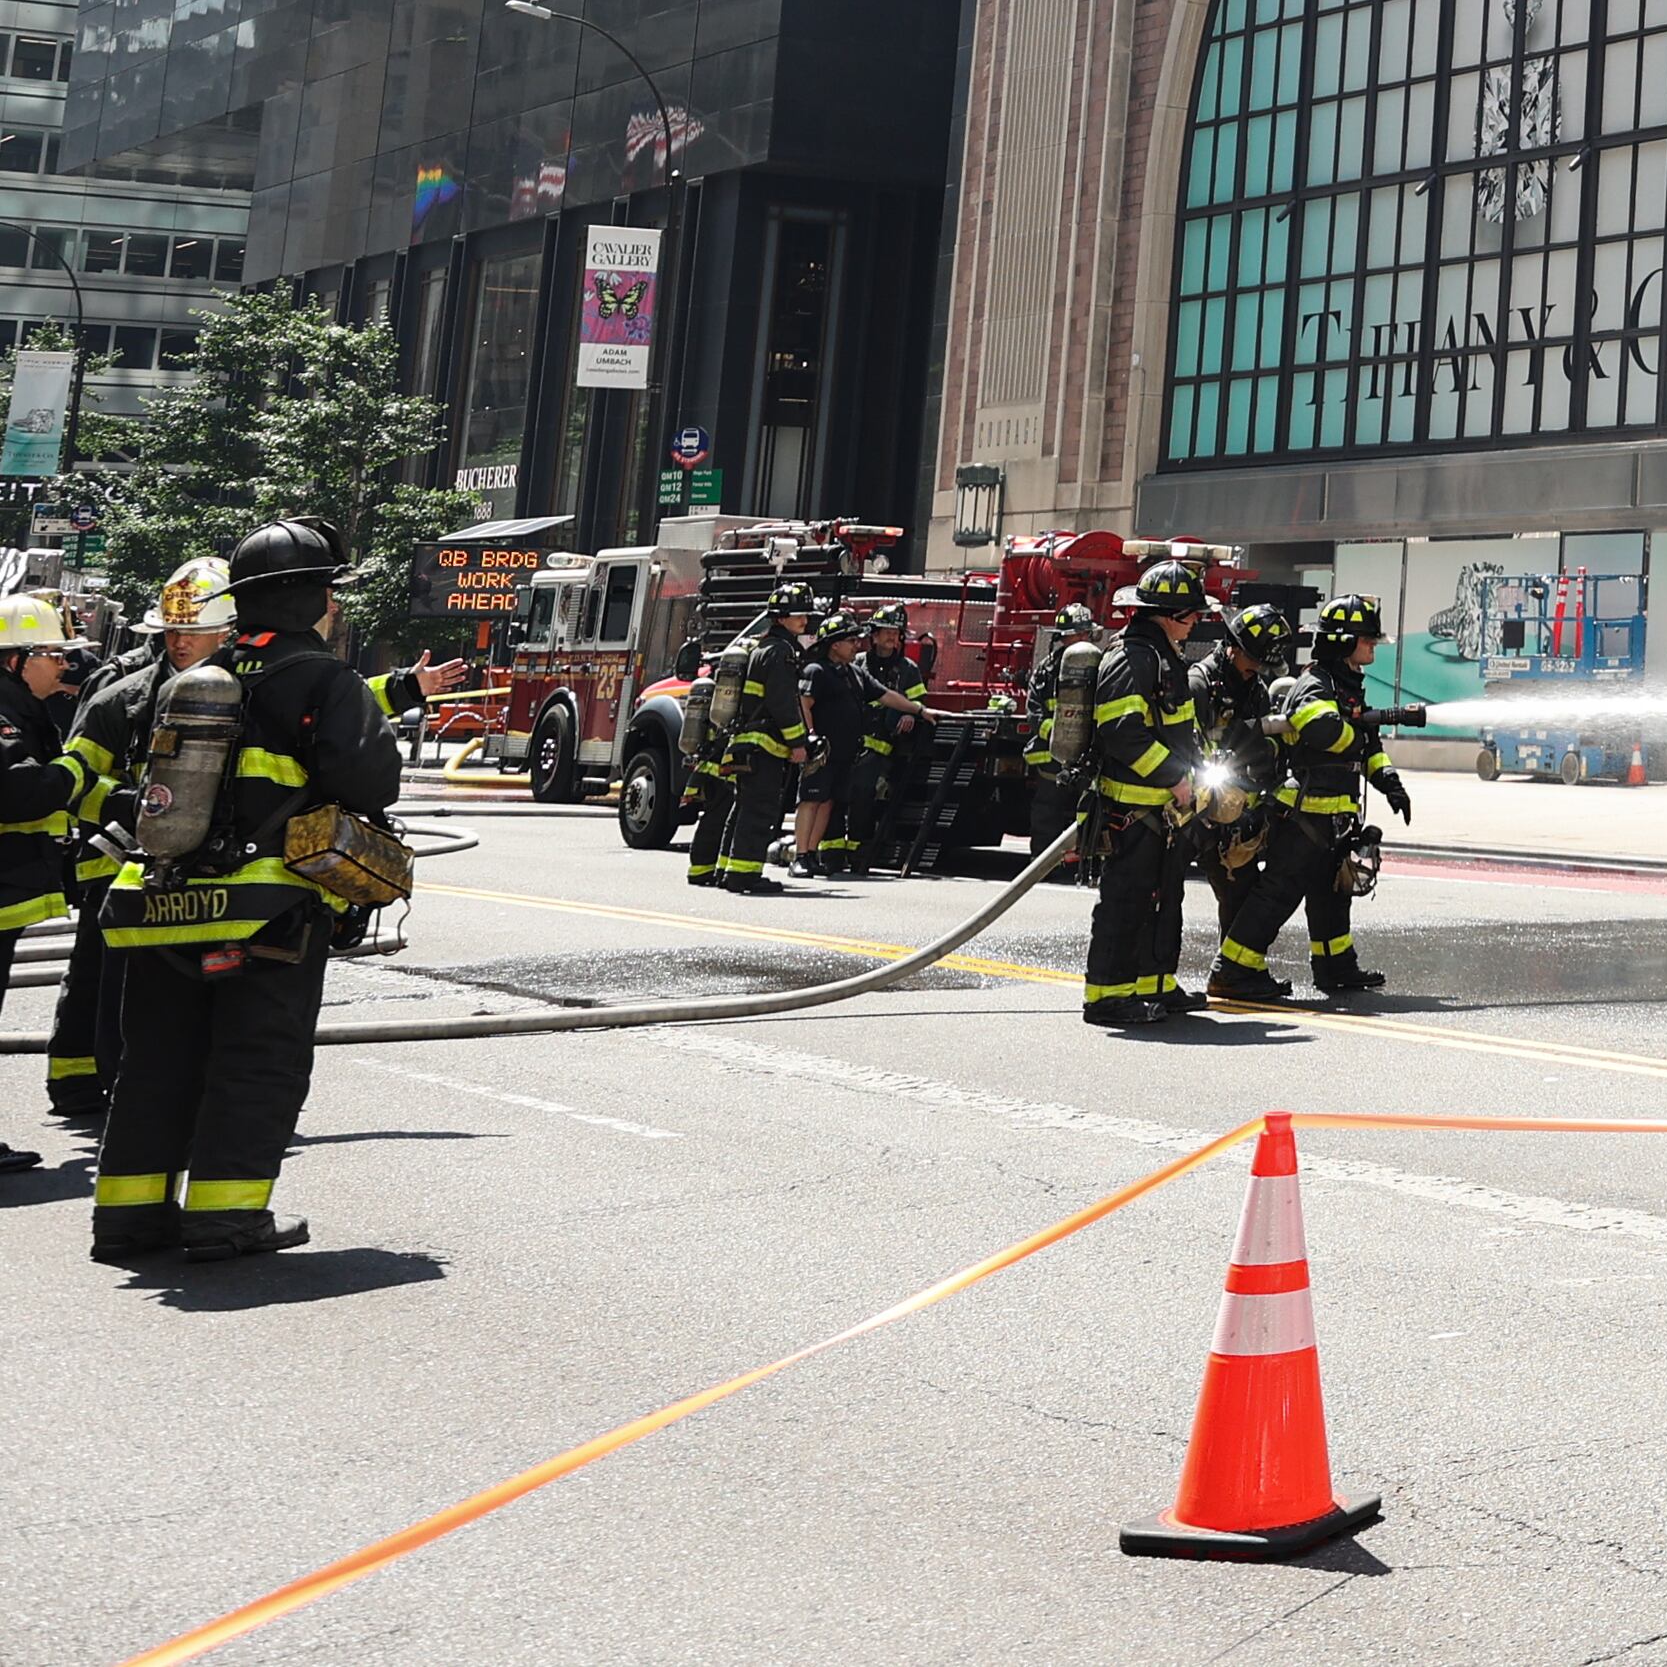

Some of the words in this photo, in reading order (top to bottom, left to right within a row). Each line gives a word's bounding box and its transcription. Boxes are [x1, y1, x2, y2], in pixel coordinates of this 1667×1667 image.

[592, 241, 652, 255] CAVALIER
[592, 253, 652, 267] GALLERY
[602, 347, 627, 357] ADAM
[596, 358, 632, 366] UMBACH
[977, 415, 1039, 450] COURAGE
[455, 464, 518, 492] BUCHERER
[438, 550, 468, 567] QB
[482, 551, 539, 569] BRDG
[457, 572, 513, 589] WORK
[447, 593, 518, 610] AHEAD
[596, 664, 618, 700] 23
[142, 888, 228, 922] ARROYO
